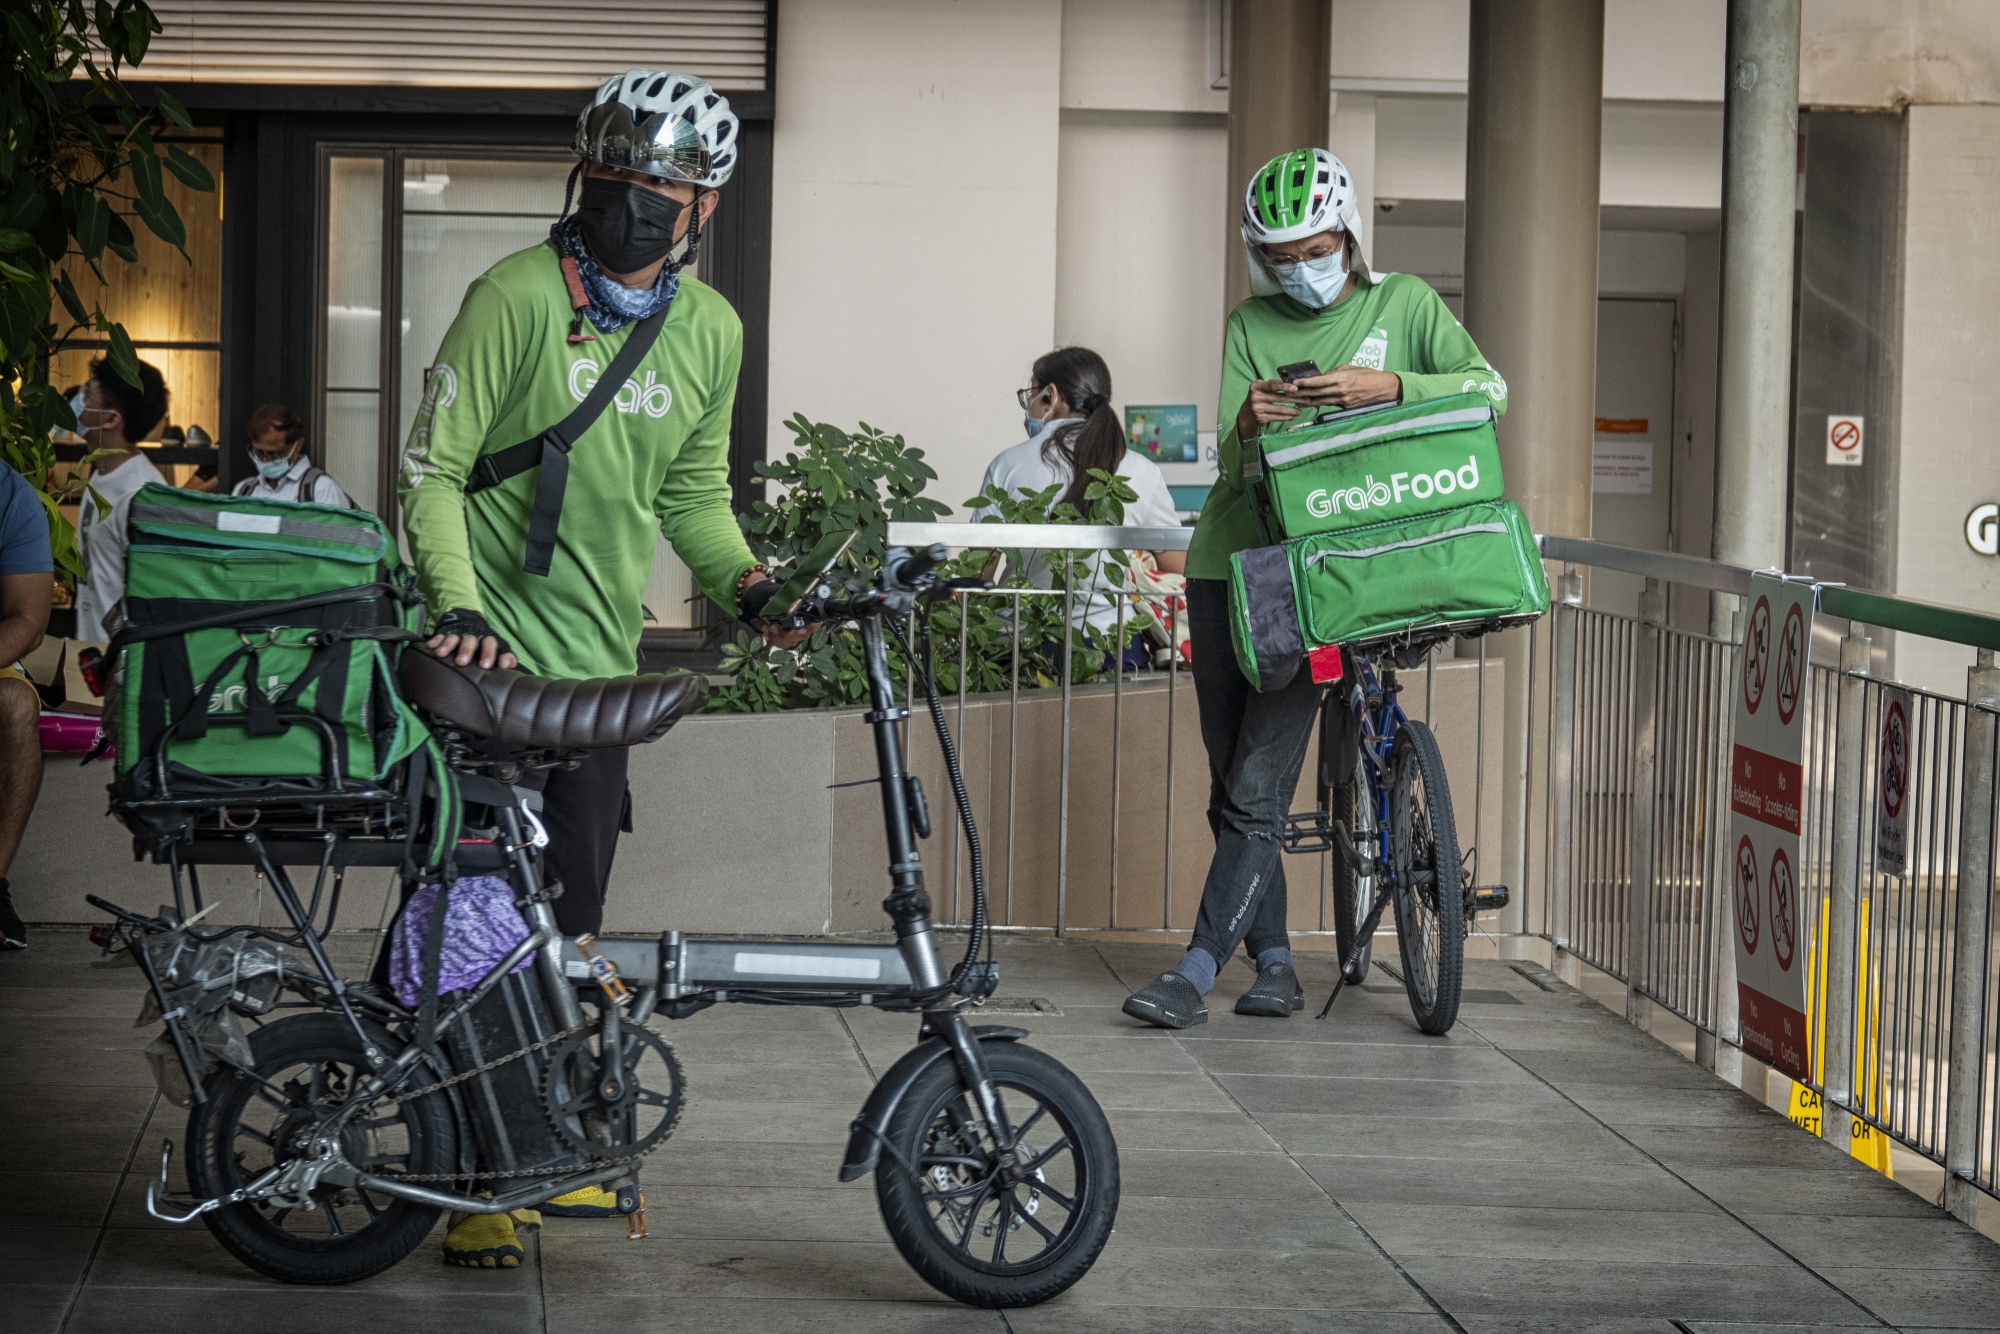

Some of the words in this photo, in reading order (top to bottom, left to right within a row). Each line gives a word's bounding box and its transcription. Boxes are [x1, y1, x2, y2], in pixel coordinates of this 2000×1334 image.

[1357, 343, 1382, 357] rab
[568, 358, 673, 419] Gab
[1306, 455, 1480, 518] GrabFood
[1745, 760, 1752, 778] No
[1778, 771, 1786, 791] No
[1734, 783, 1761, 815] Rollerblading
[1764, 794, 1799, 828] Scooter-riding
[1750, 999, 1758, 1019] No
[1783, 1016, 1792, 1037] No
[1780, 1042, 1800, 1071] Cycling
